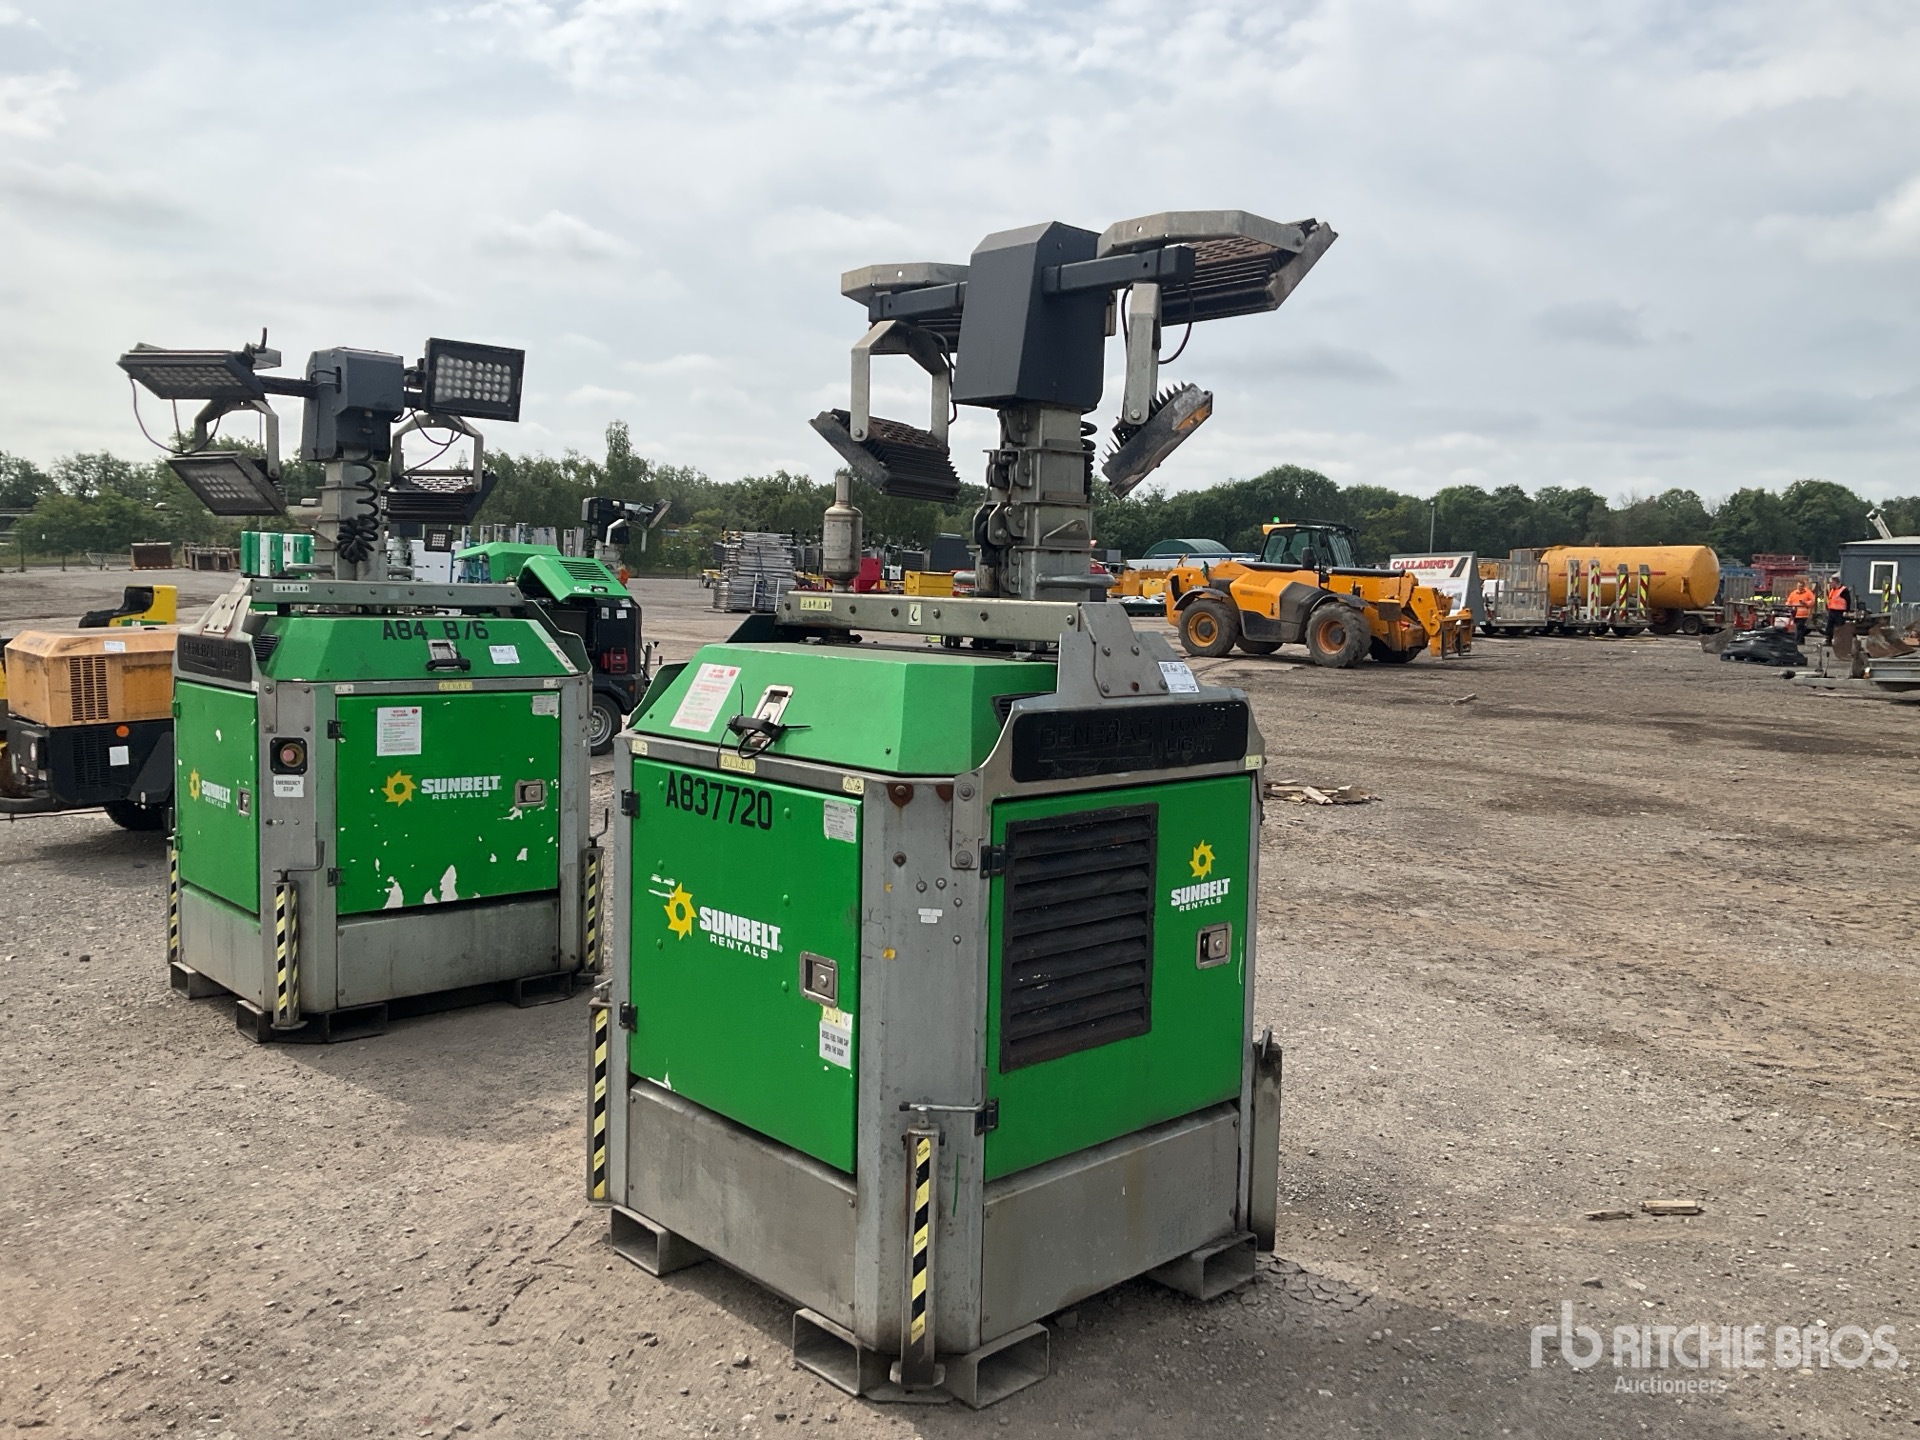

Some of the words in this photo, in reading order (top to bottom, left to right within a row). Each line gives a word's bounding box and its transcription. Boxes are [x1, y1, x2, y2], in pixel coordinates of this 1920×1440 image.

[1392, 559, 1454, 569] CALLADINE'S
[1039, 717, 1153, 750] GENERAC
[1168, 713, 1229, 734] TOWER
[1166, 734, 1216, 753] LIGHT
[201, 780, 231, 804] SUNBELT
[421, 775, 501, 794] SUNBELT
[432, 791, 489, 800] RENTALS
[665, 770, 773, 831] A837720
[1170, 877, 1231, 907] SUNBELT
[1179, 896, 1222, 912] RENTALS
[699, 906, 781, 952] SUNBELT
[710, 933, 769, 960] RENTALS
